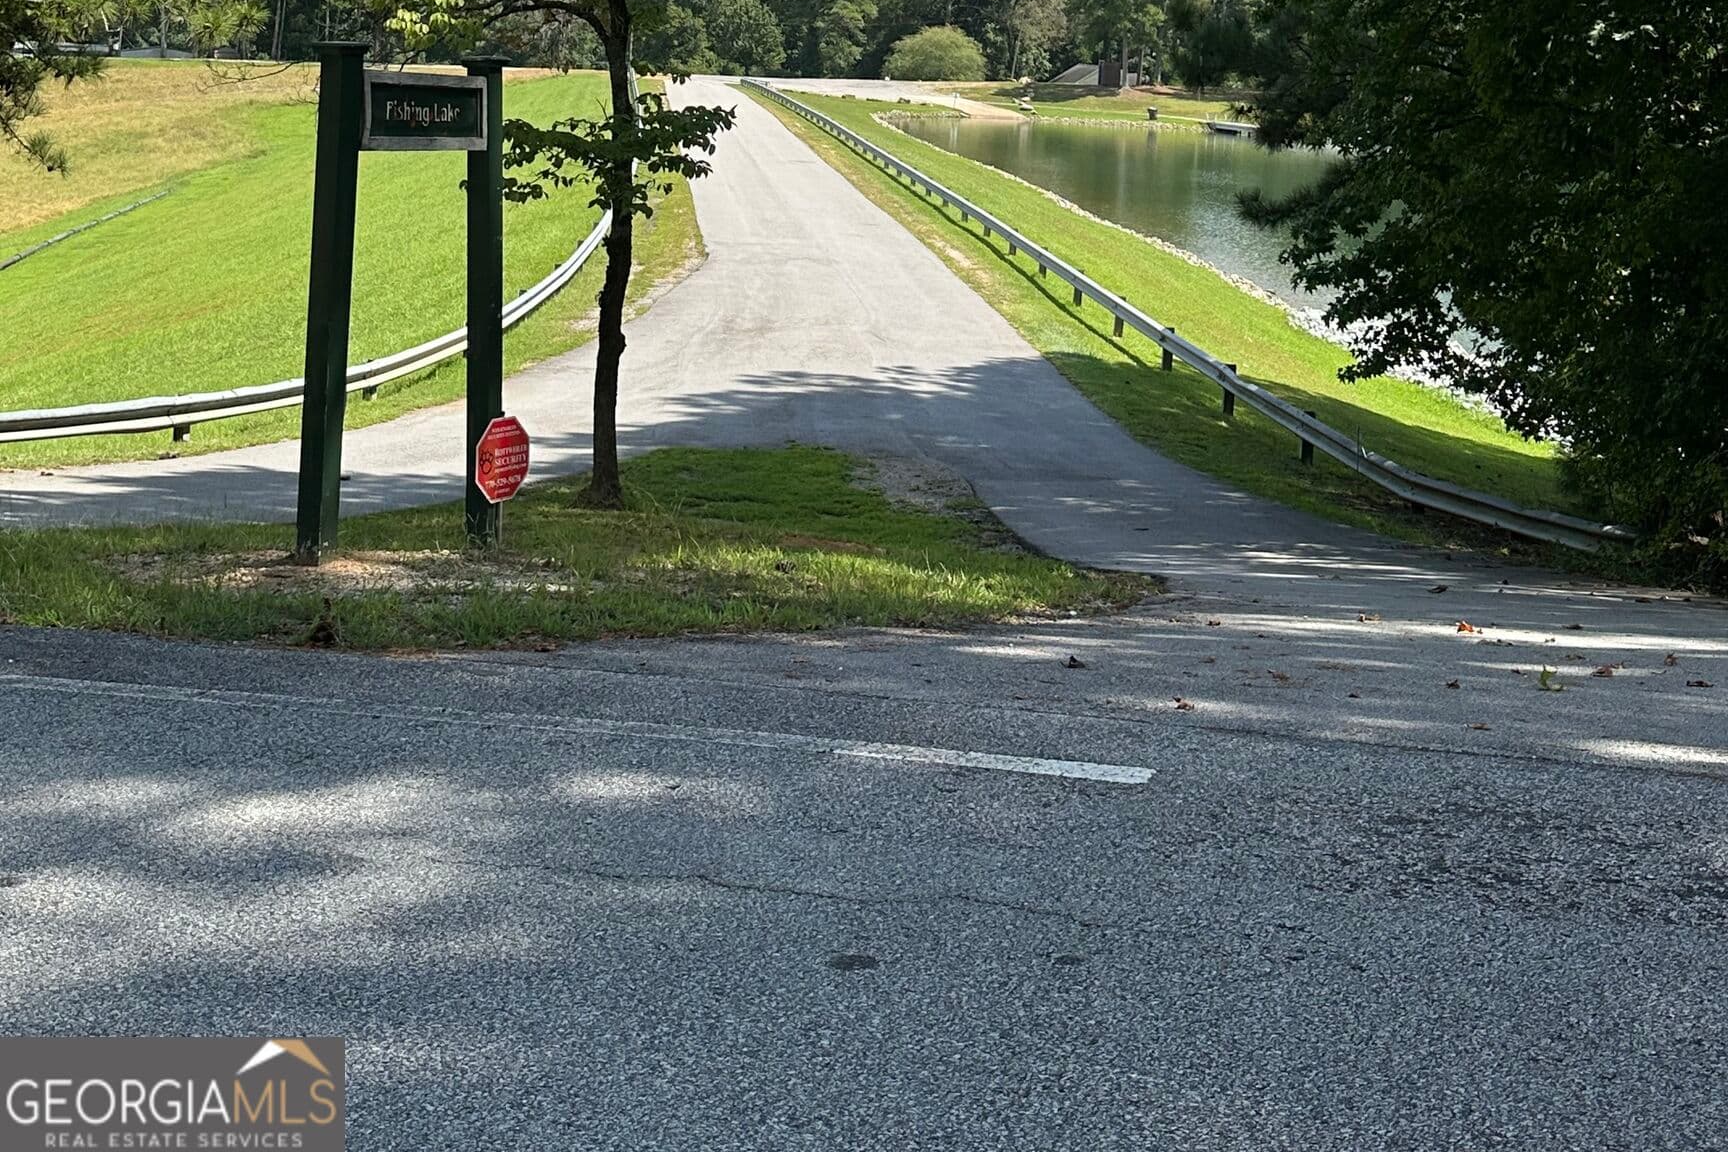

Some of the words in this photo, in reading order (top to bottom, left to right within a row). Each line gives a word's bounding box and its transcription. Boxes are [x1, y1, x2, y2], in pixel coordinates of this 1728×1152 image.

[386, 100, 430, 127] Fishing
[434, 103, 461, 122] Lake
[495, 454, 527, 466] SECURITY
